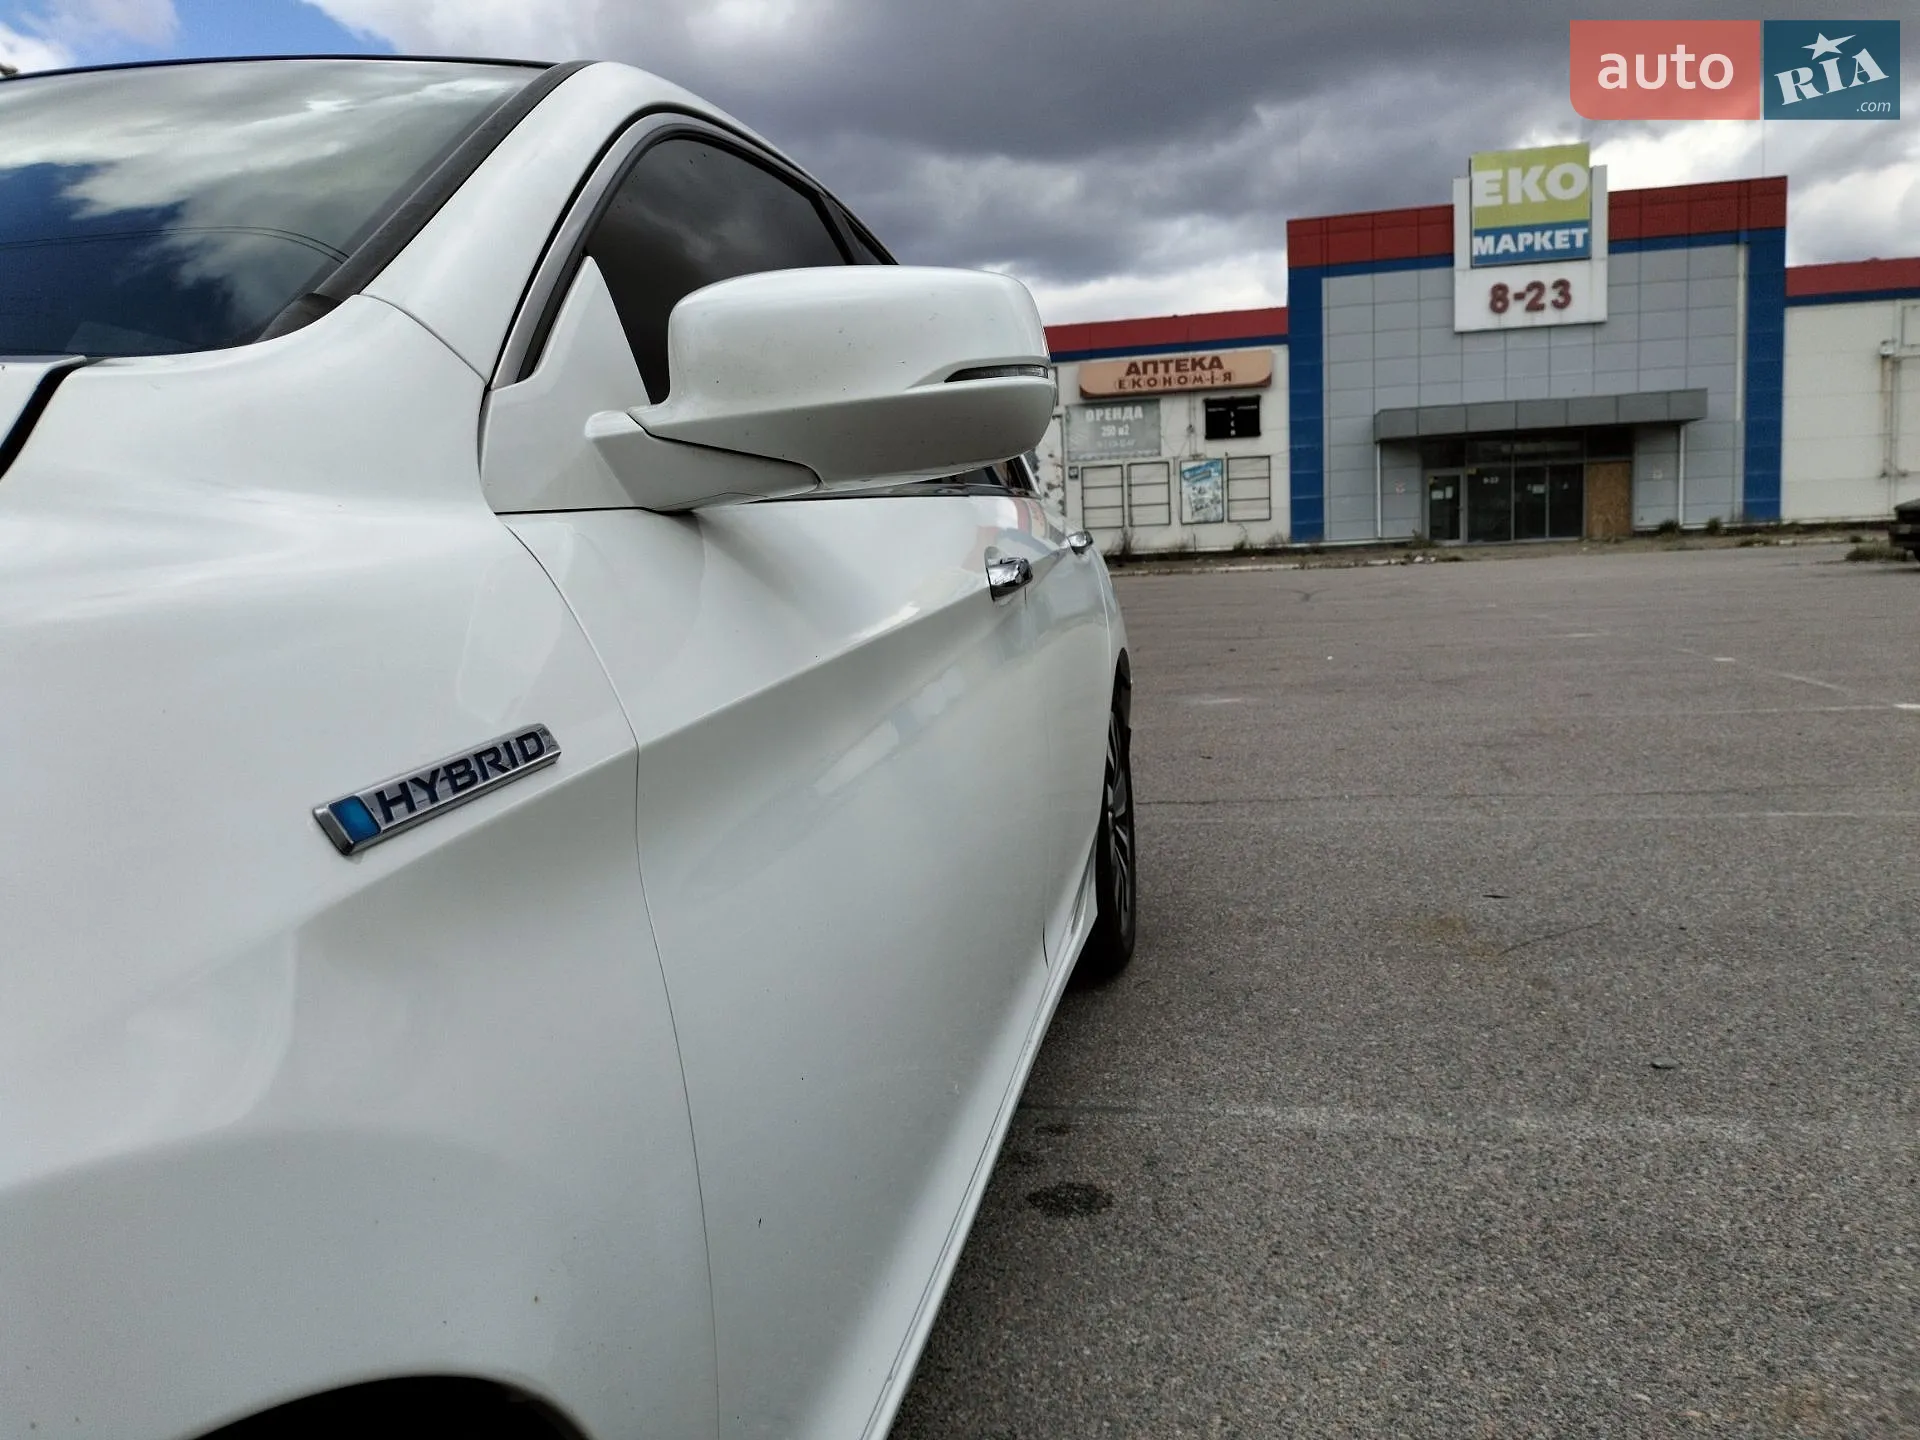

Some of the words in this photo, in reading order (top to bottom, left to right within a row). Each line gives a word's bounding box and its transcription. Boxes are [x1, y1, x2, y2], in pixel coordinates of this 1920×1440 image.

[1472, 162, 1590, 208] ЕКО
[1473, 227, 1589, 256] МАРКЕТ
[1489, 278, 1572, 314] 8-23
[1118, 371, 1232, 389] ЕКОНОМІЯ
[1125, 356, 1224, 376] АПТЕКА
[1085, 406, 1144, 422] ОРЕНДА
[375, 731, 545, 824] HYBRID
